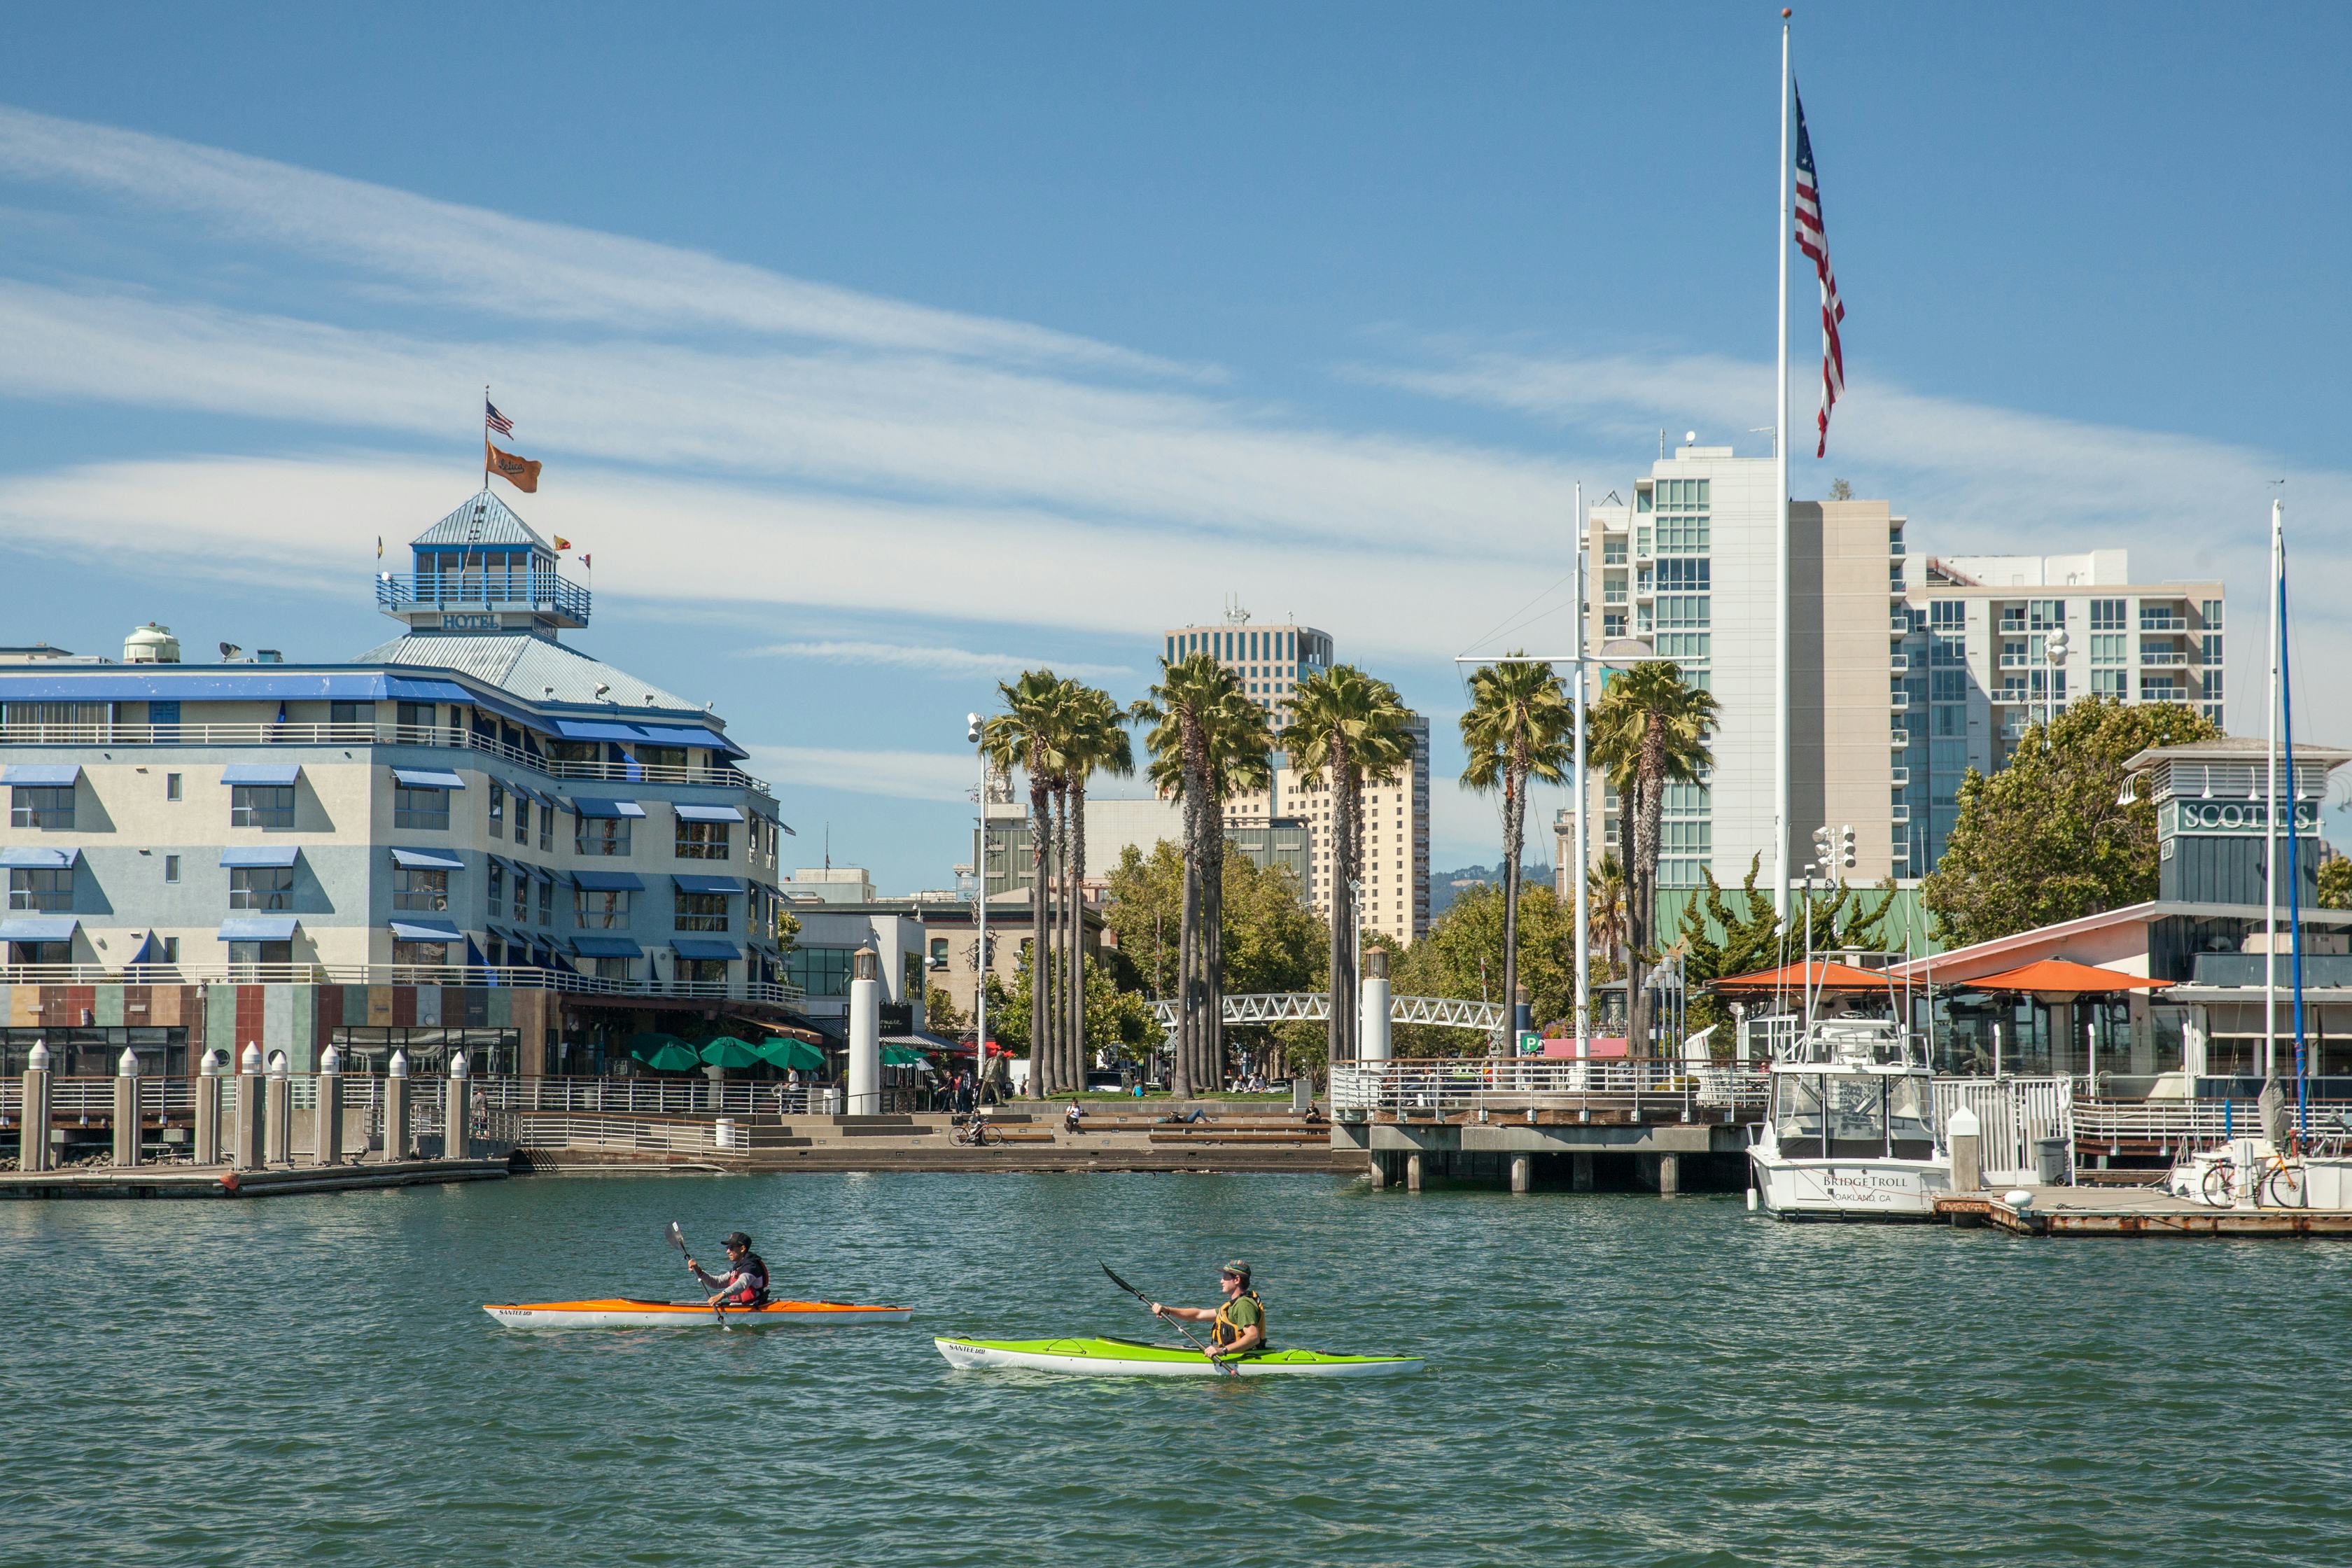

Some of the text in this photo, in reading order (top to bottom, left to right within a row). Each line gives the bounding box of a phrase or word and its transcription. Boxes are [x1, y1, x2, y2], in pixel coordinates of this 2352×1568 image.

[442, 614, 499, 629] HOTEL
[1527, 1037, 1536, 1049] P
[949, 1344, 975, 1353] SANTEE
